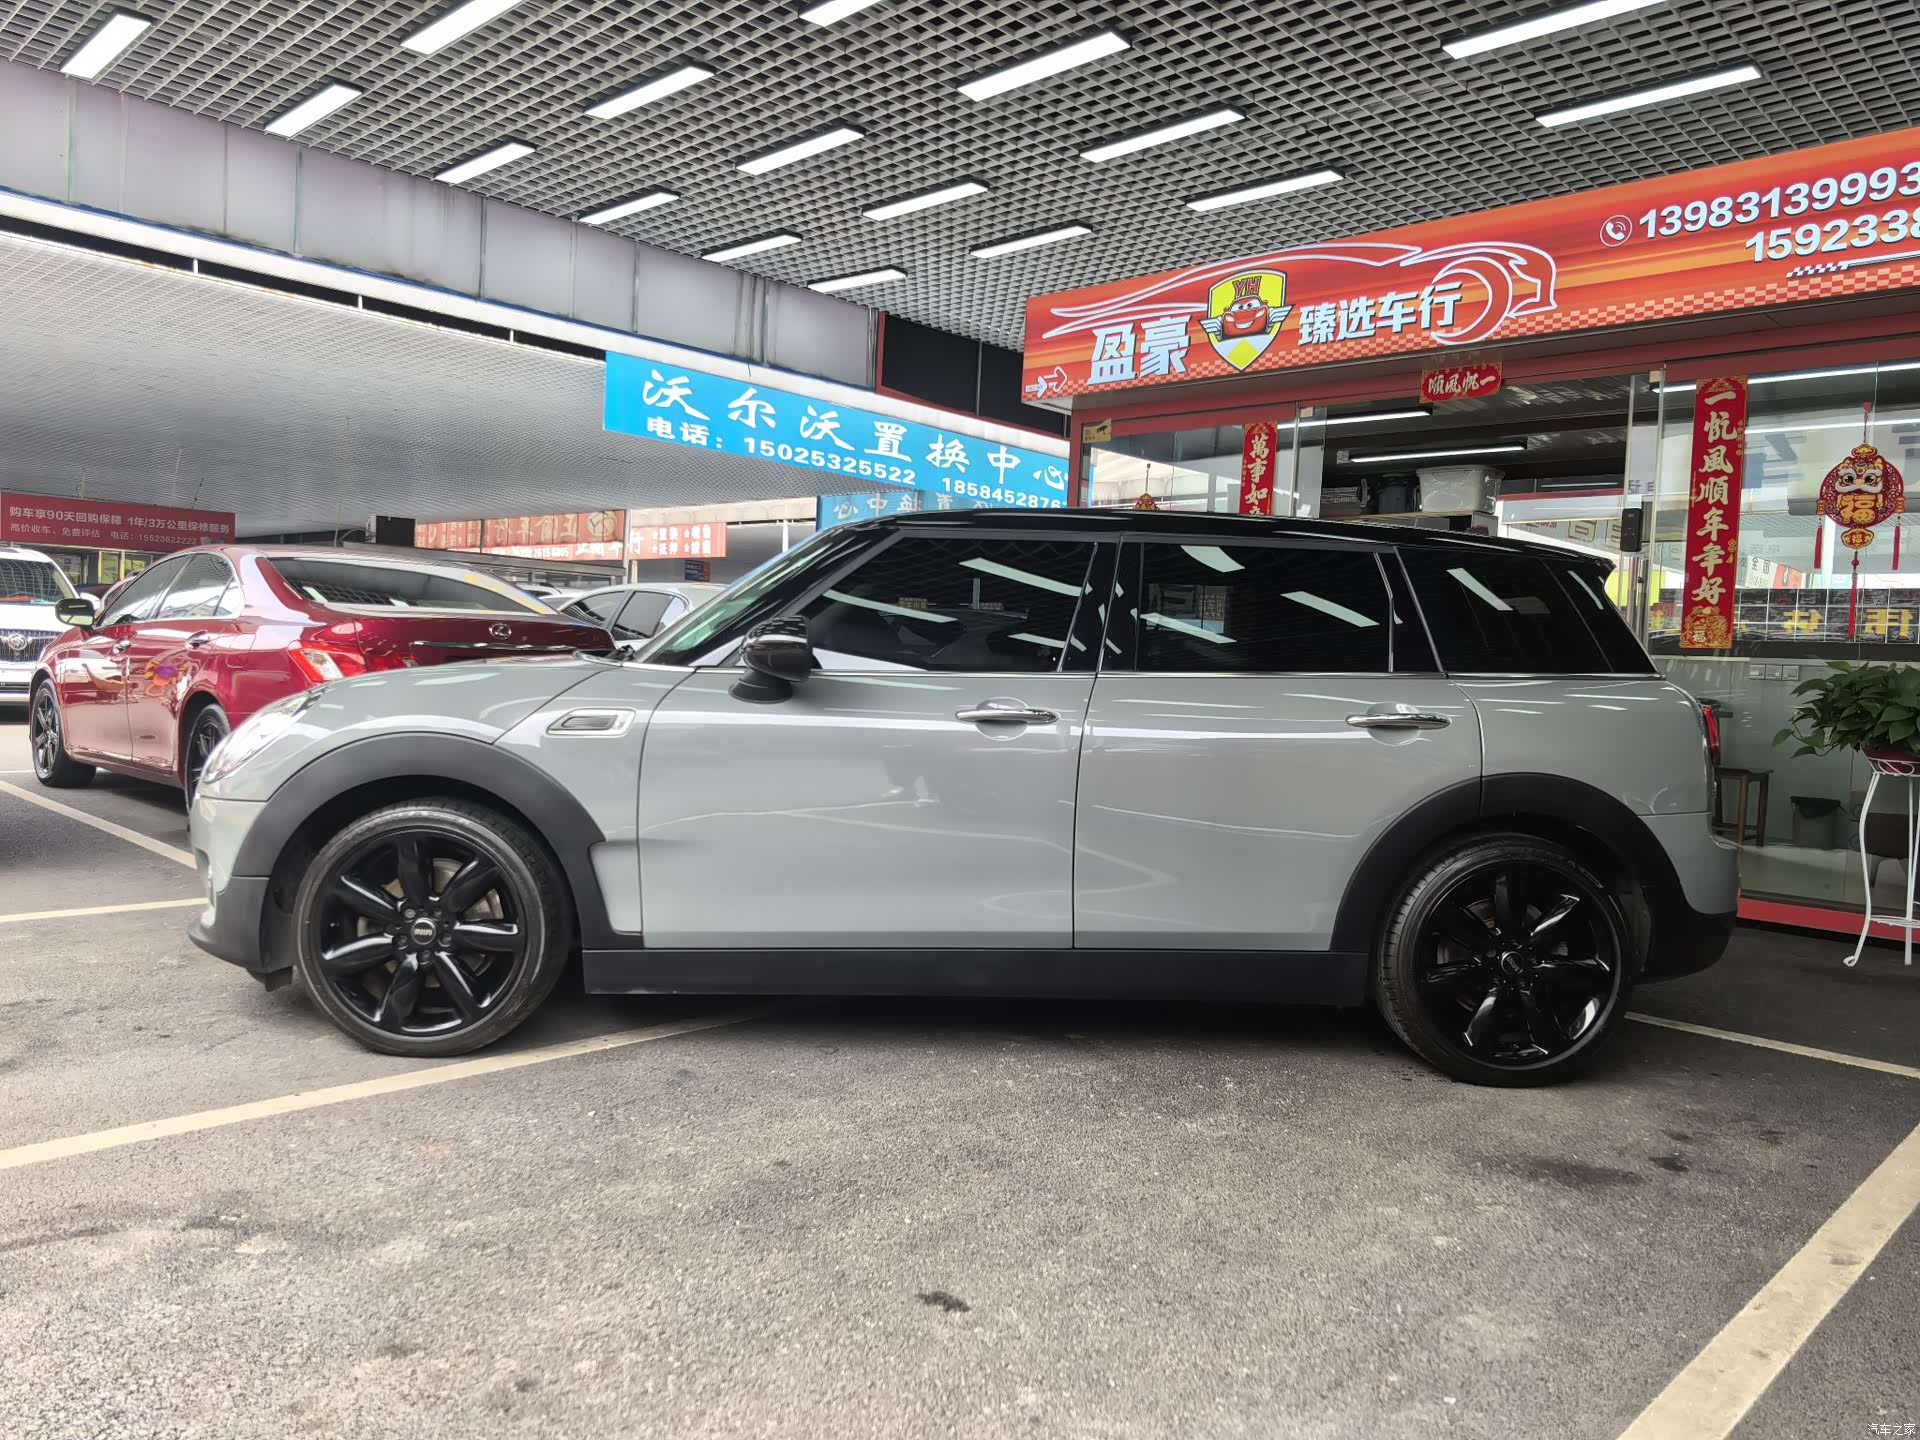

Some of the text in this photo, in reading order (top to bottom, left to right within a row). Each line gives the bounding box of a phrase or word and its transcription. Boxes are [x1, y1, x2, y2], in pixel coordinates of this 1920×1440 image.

[1639, 161, 1920, 239] 13983139993
[1232, 276, 1262, 298] YH
[1298, 282, 1463, 345] 臻选车行
[1087, 314, 1192, 385] 盈豪
[642, 369, 1068, 490] 沃尔沃置换中心
[942, 477, 1068, 508] 1858452876
[1841, 494, 1876, 525] 福
